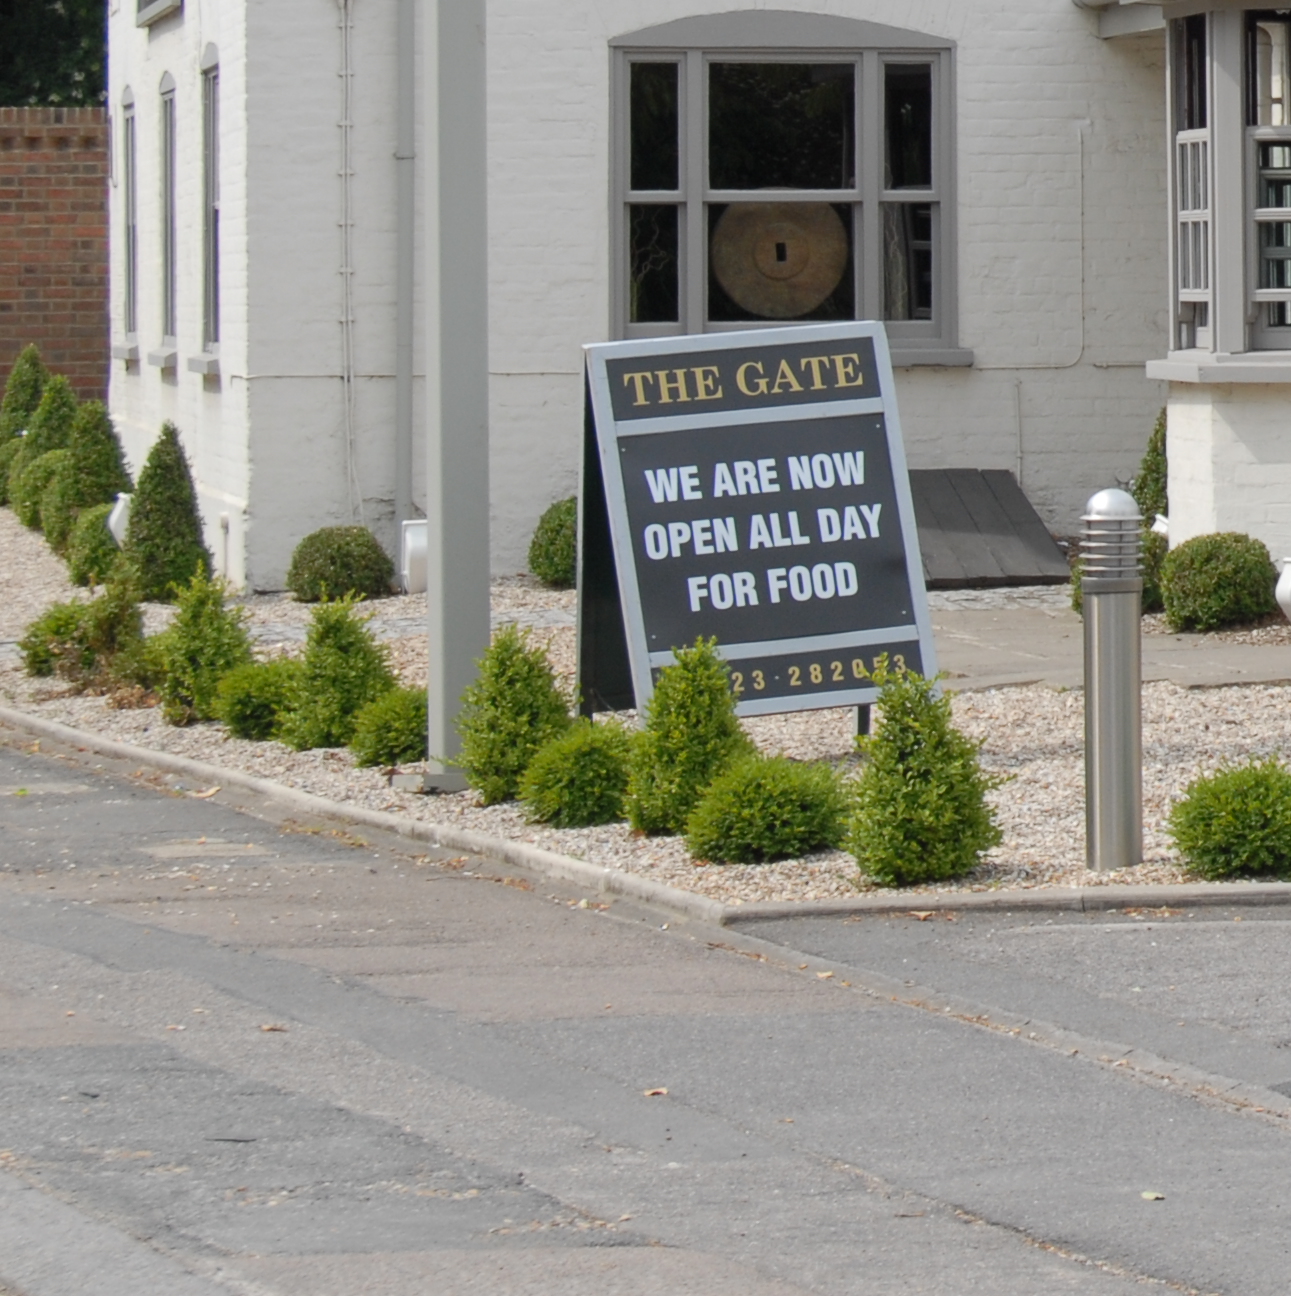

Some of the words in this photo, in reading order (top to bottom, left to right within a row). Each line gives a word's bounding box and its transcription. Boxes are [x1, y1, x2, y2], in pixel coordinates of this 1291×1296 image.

[623, 365, 724, 406] THE
[736, 352, 864, 396] GATE
[644, 465, 703, 504] WE
[713, 458, 781, 498] ARE
[788, 450, 865, 492] NOW
[643, 516, 739, 560] OPEN
[749, 510, 810, 550] ALL
[817, 504, 882, 543] DAY
[687, 571, 759, 612] FOR
[767, 561, 859, 604] FOOD
